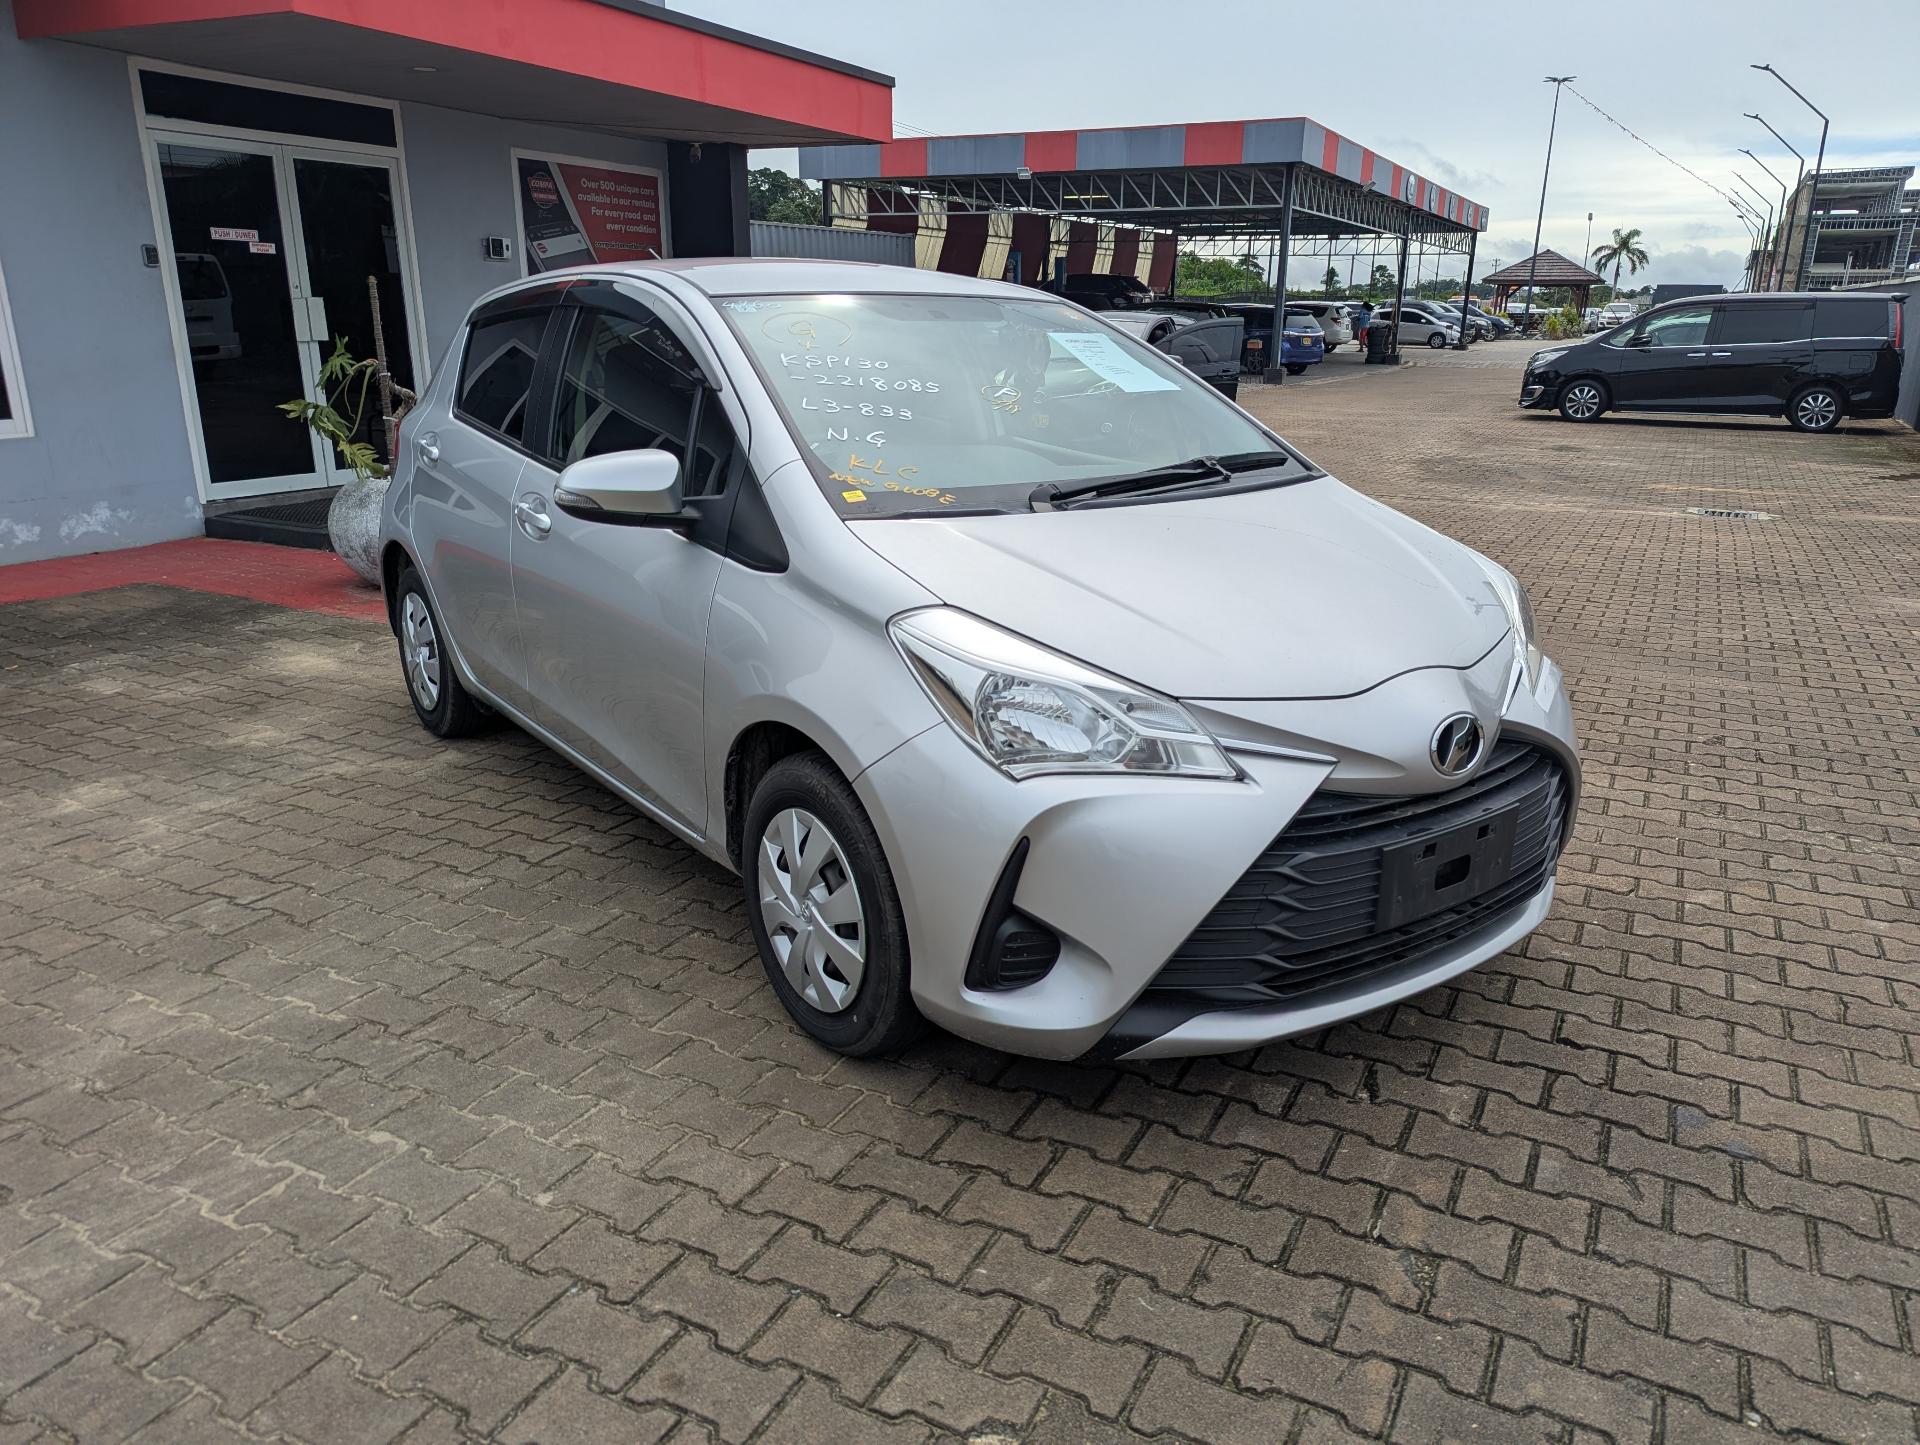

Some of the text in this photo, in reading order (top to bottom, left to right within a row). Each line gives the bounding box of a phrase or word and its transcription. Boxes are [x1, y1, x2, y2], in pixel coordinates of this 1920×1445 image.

[581, 178, 656, 196] Over 500 unique cars
[577, 193, 656, 209] available in our rentals
[591, 206, 656, 222] For every road and
[213, 229, 231, 238] PUSH
[606, 223, 657, 235] every condition
[780, 352, 889, 370] KSP130
[802, 397, 913, 421] L3-833
[849, 454, 919, 481] KLC
